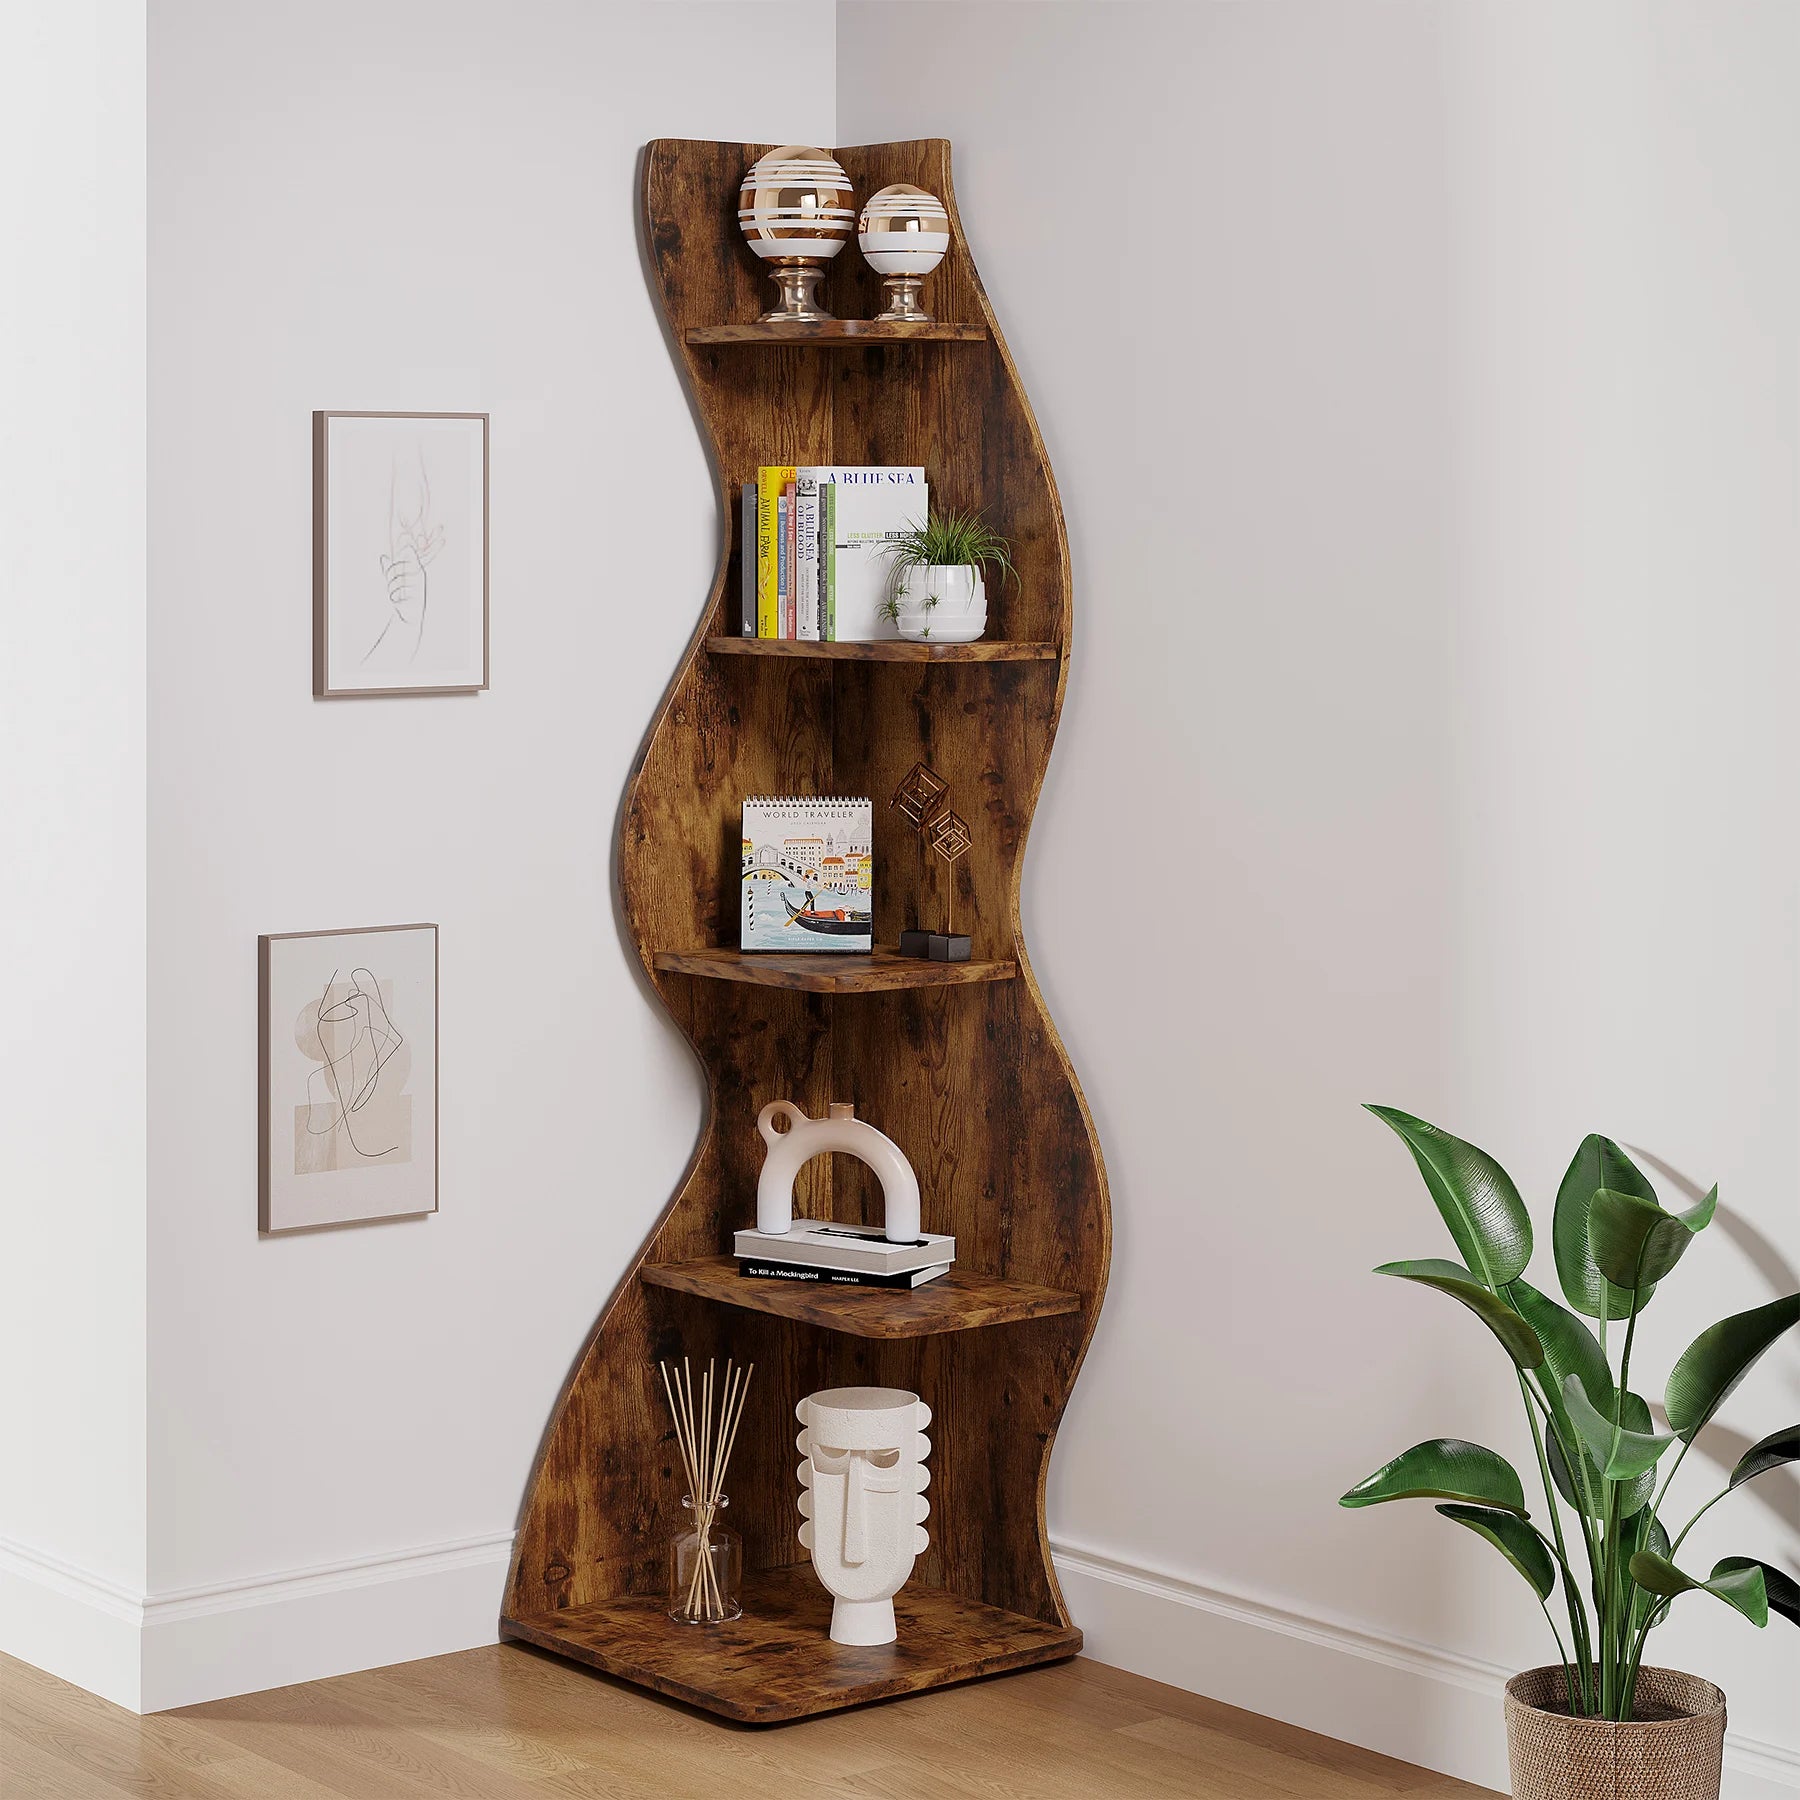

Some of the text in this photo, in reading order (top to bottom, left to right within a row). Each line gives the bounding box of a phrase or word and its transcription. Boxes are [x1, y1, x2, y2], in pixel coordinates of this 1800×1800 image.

[828, 472, 837, 484] A
[798, 505, 804, 519] OF
[760, 497, 771, 559] ANIMAL FARM
[806, 513, 814, 540] BLUE
[806, 542, 814, 561] SEA
[762, 811, 800, 819] WORLD
[776, 1270, 819, 1279] Mockingbird
